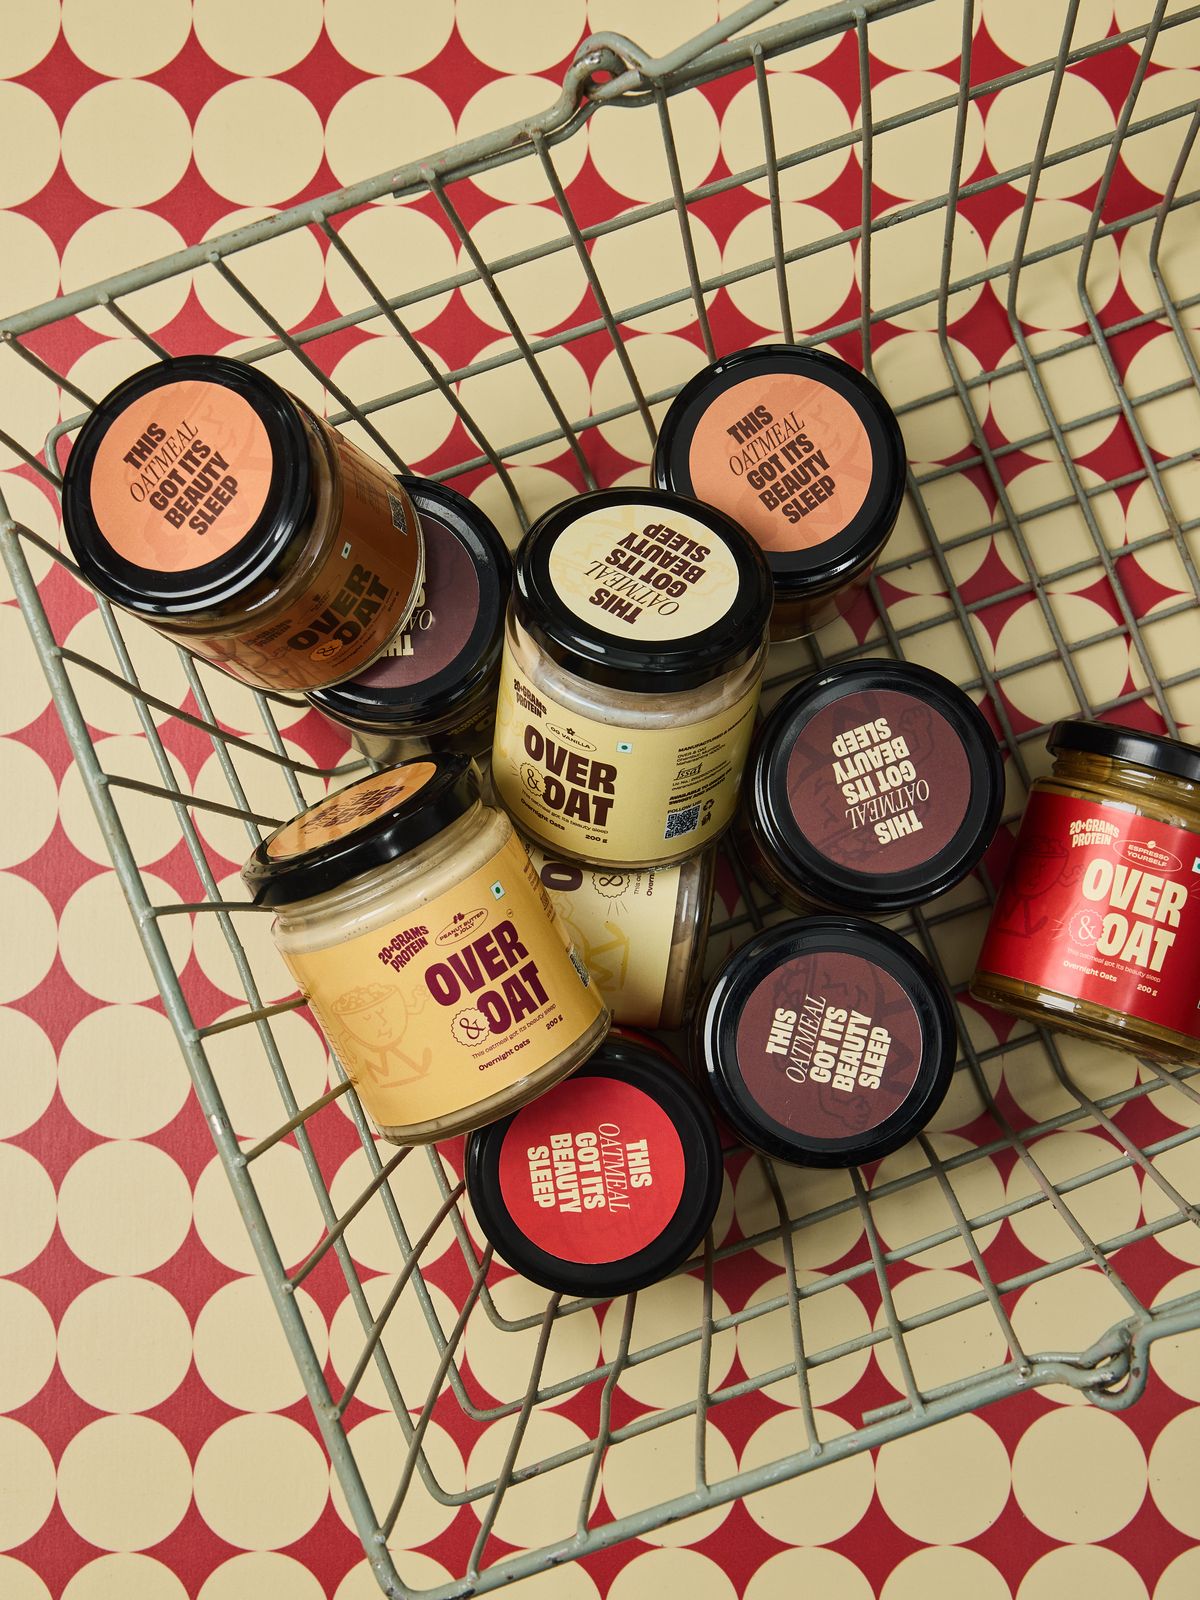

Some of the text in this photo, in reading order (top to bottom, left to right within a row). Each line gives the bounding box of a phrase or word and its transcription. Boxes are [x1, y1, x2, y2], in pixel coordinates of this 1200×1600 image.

[123, 422, 167, 470] THIS
[726, 405, 773, 445] THIS
[729, 410, 805, 476] OATMEAL
[130, 419, 199, 503] OATMEAL
[149, 439, 211, 511] GOT ITS
[746, 433, 814, 490] GOT ITS
[758, 449, 830, 512] BEAUTY
[163, 450, 230, 529] BEAUTY
[188, 475, 238, 536] SLEEP
[781, 475, 836, 524] SLEEP
[616, 531, 706, 584] BEAUTY
[642, 523, 711, 563] SLEEP
[584, 560, 680, 616] OATMEAL
[605, 548, 688, 598] GOT ITS
[287, 563, 372, 650] OVER
[332, 574, 389, 646] OAT
[588, 587, 643, 625] THIS
[513, 678, 547, 715] 20+GRAMS
[516, 692, 542, 718] PROTEIN
[524, 724, 617, 795] OVER
[562, 732, 591, 749] VANILLA
[832, 717, 892, 758] SLEEP
[832, 735, 910, 785] BEAUTY
[527, 768, 614, 827] & OAT
[841, 760, 917, 805] GOT ITS
[845, 779, 930, 830] OATMEAL
[520, 798, 565, 831] Overnight Oats
[570, 820, 591, 831] beauty
[592, 827, 608, 835] sleep
[585, 834, 601, 842] 200
[873, 809, 924, 845] THIS
[1069, 818, 1120, 839] 20+GRAMS
[1071, 832, 1112, 848] PROTEIN
[1127, 850, 1168, 867] YOURSELF
[1128, 844, 1170, 862] ESPRESSO
[1082, 858, 1189, 928] OVER
[377, 924, 430, 966] 20+GRAMS
[439, 910, 485, 941] PEANUT BUTTER
[459, 922, 475, 935] JOLLY
[1078, 912, 1177, 973] & OAT
[389, 936, 429, 973] PROTEIN
[424, 919, 530, 1007] OVER
[1063, 960, 1117, 982] Overnight Oats
[1079, 952, 1104, 965] oatmeal
[1104, 959, 1115, 968] got
[1115, 962, 1124, 970] its
[1124, 965, 1146, 978] beauty
[1145, 973, 1161, 983] sleep
[459, 960, 550, 1040] & OAT
[1136, 983, 1152, 994] 200
[472, 1003, 557, 1060] This oatmeal got its beauty sleep
[545, 1014, 564, 1030] 200 g
[765, 1007, 798, 1055] THIS
[785, 994, 827, 1084] OATMEAL
[809, 1006, 848, 1084] GOT ITS
[478, 1038, 531, 1071] Overnight Oats
[831, 1009, 872, 1093] BEAUTY
[858, 1026, 892, 1090] SLEEP
[527, 1145, 556, 1208] SLEEP
[550, 1132, 582, 1213] BEAUTY
[575, 1131, 606, 1210] GOT ITS
[598, 1123, 631, 1213] OATMEAL
[625, 1139, 653, 1188] THIS
